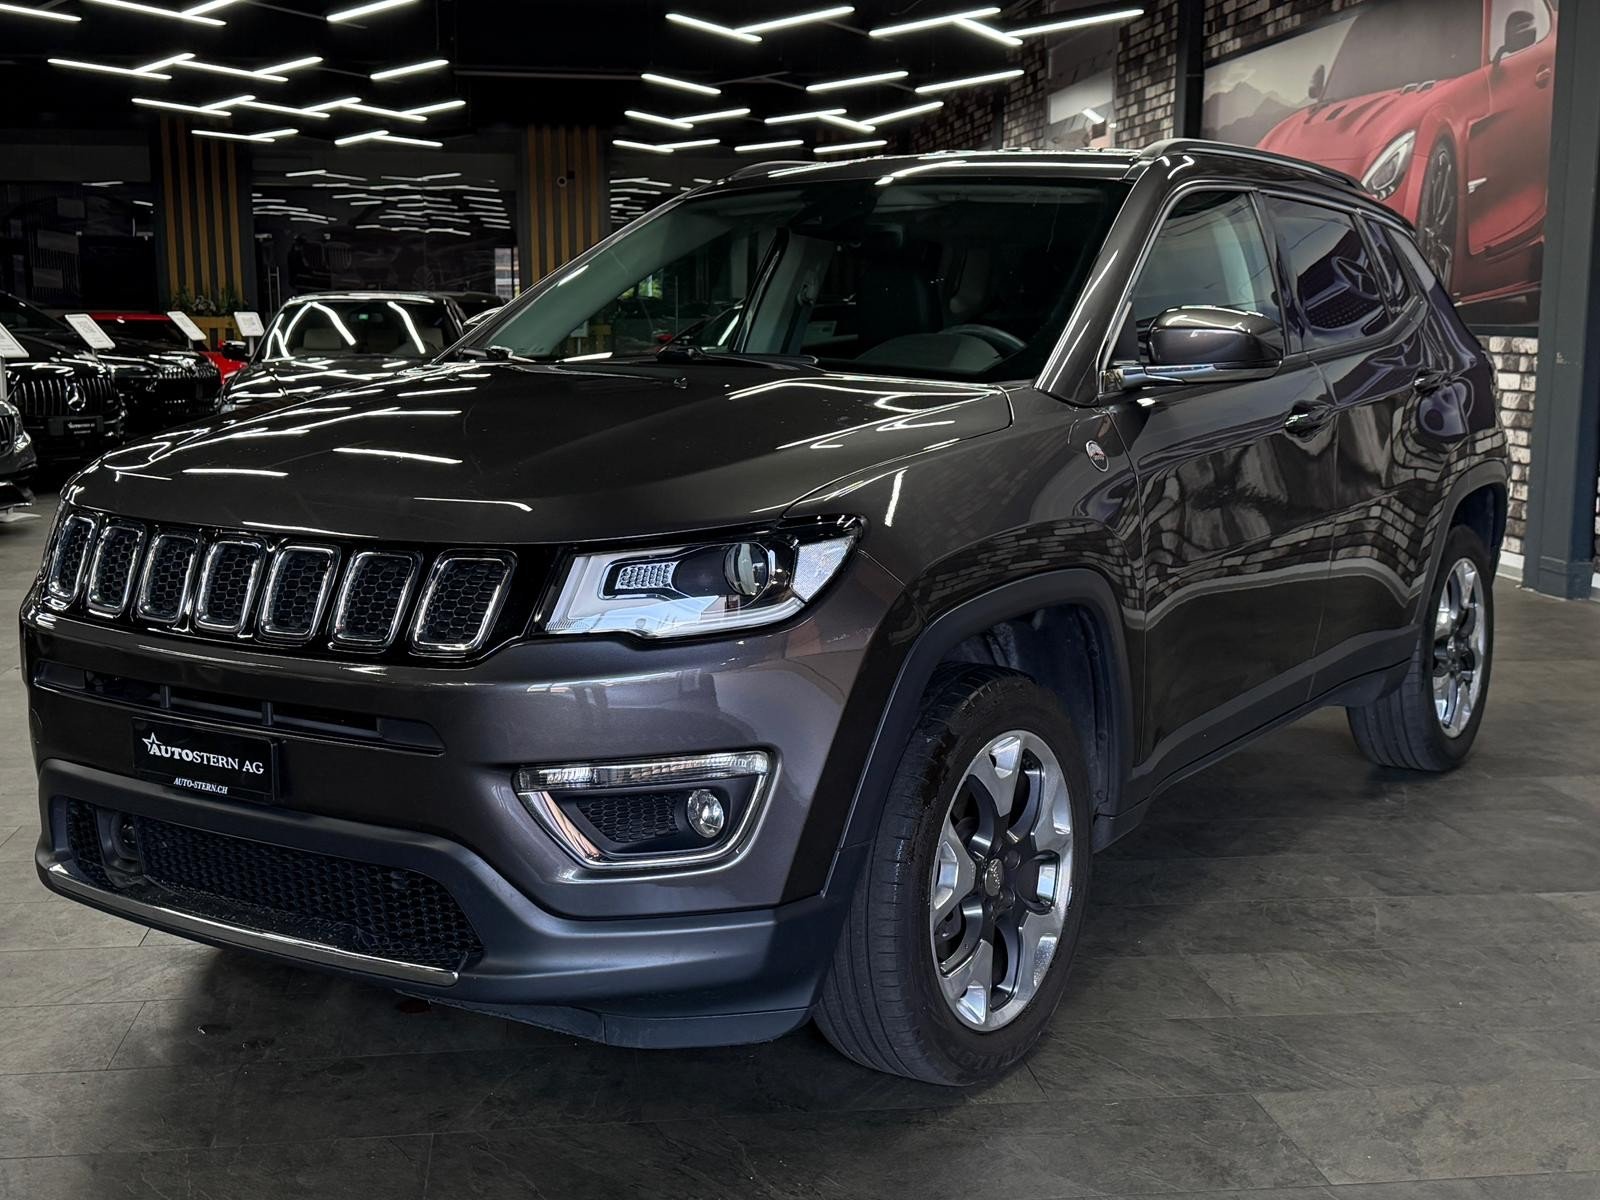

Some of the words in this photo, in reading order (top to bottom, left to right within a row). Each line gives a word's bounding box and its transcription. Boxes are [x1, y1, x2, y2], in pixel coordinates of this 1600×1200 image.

[149, 743, 239, 770] AUTOSTERN
[242, 760, 264, 775] AG
[173, 777, 228, 795] AUTO-STERN.CH
